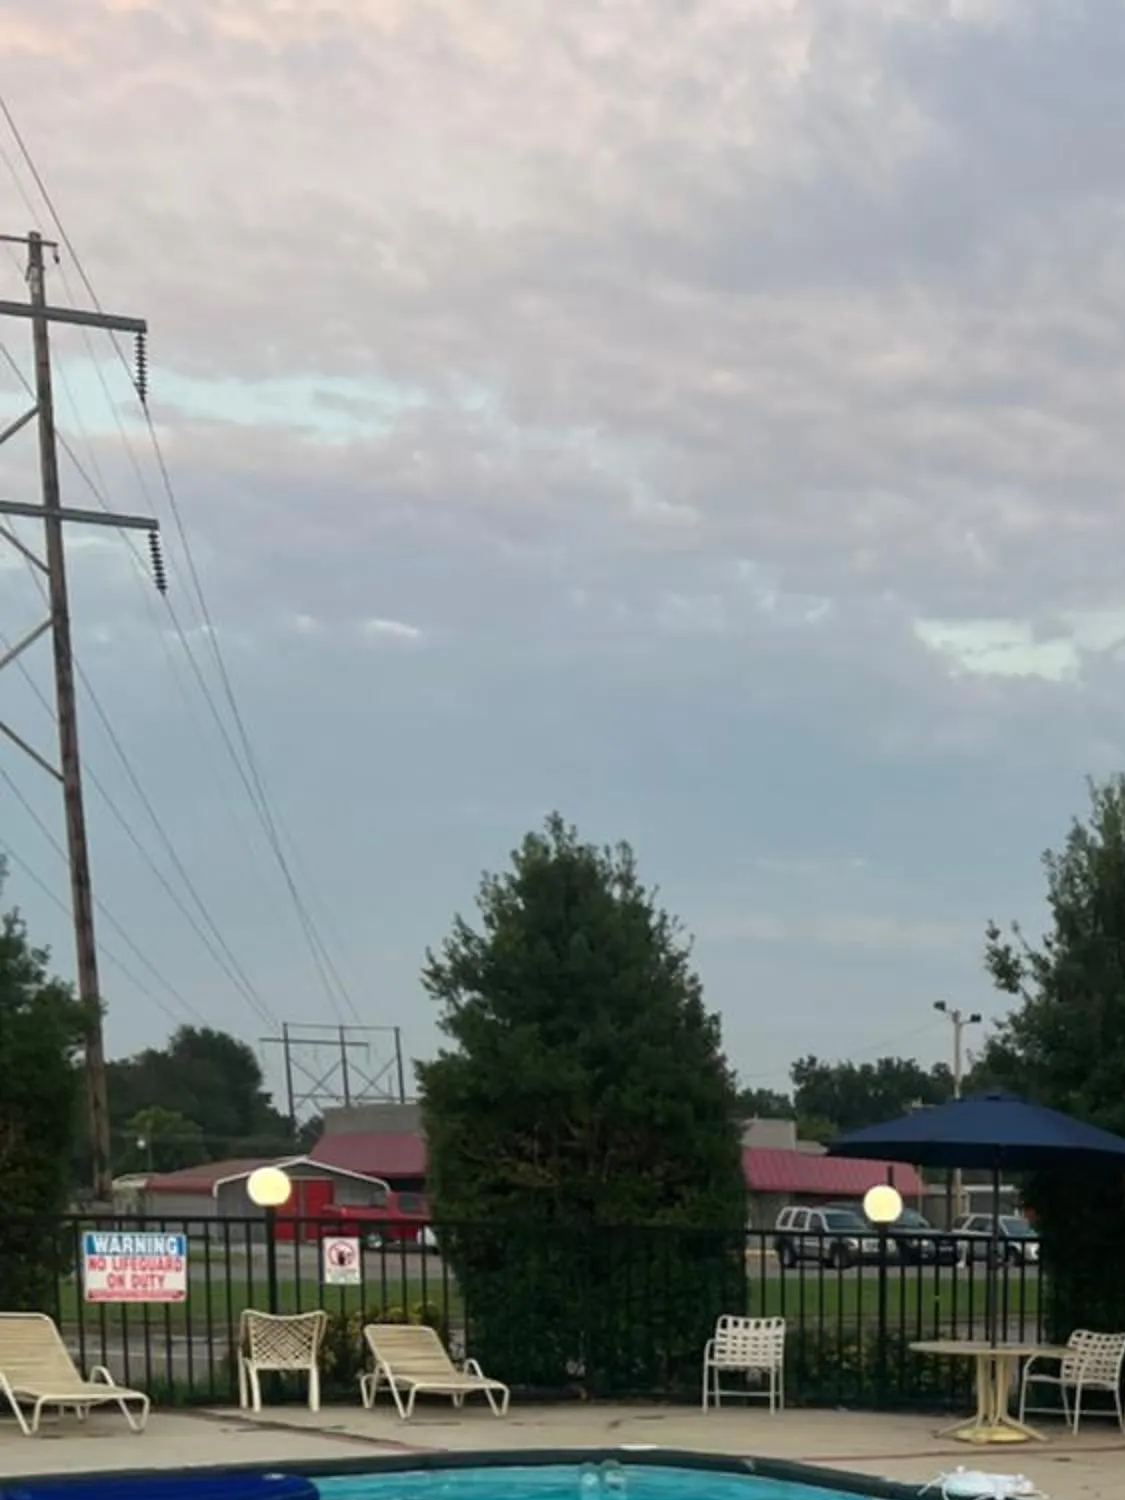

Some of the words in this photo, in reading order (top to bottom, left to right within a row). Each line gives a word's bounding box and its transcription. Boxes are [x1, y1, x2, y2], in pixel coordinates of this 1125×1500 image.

[94, 1233, 179, 1255] WARNING
[88, 1256, 107, 1272] NO
[111, 1256, 183, 1272] LIFEGUARD
[107, 1272, 126, 1289] ON
[130, 1272, 166, 1289] DUTY
